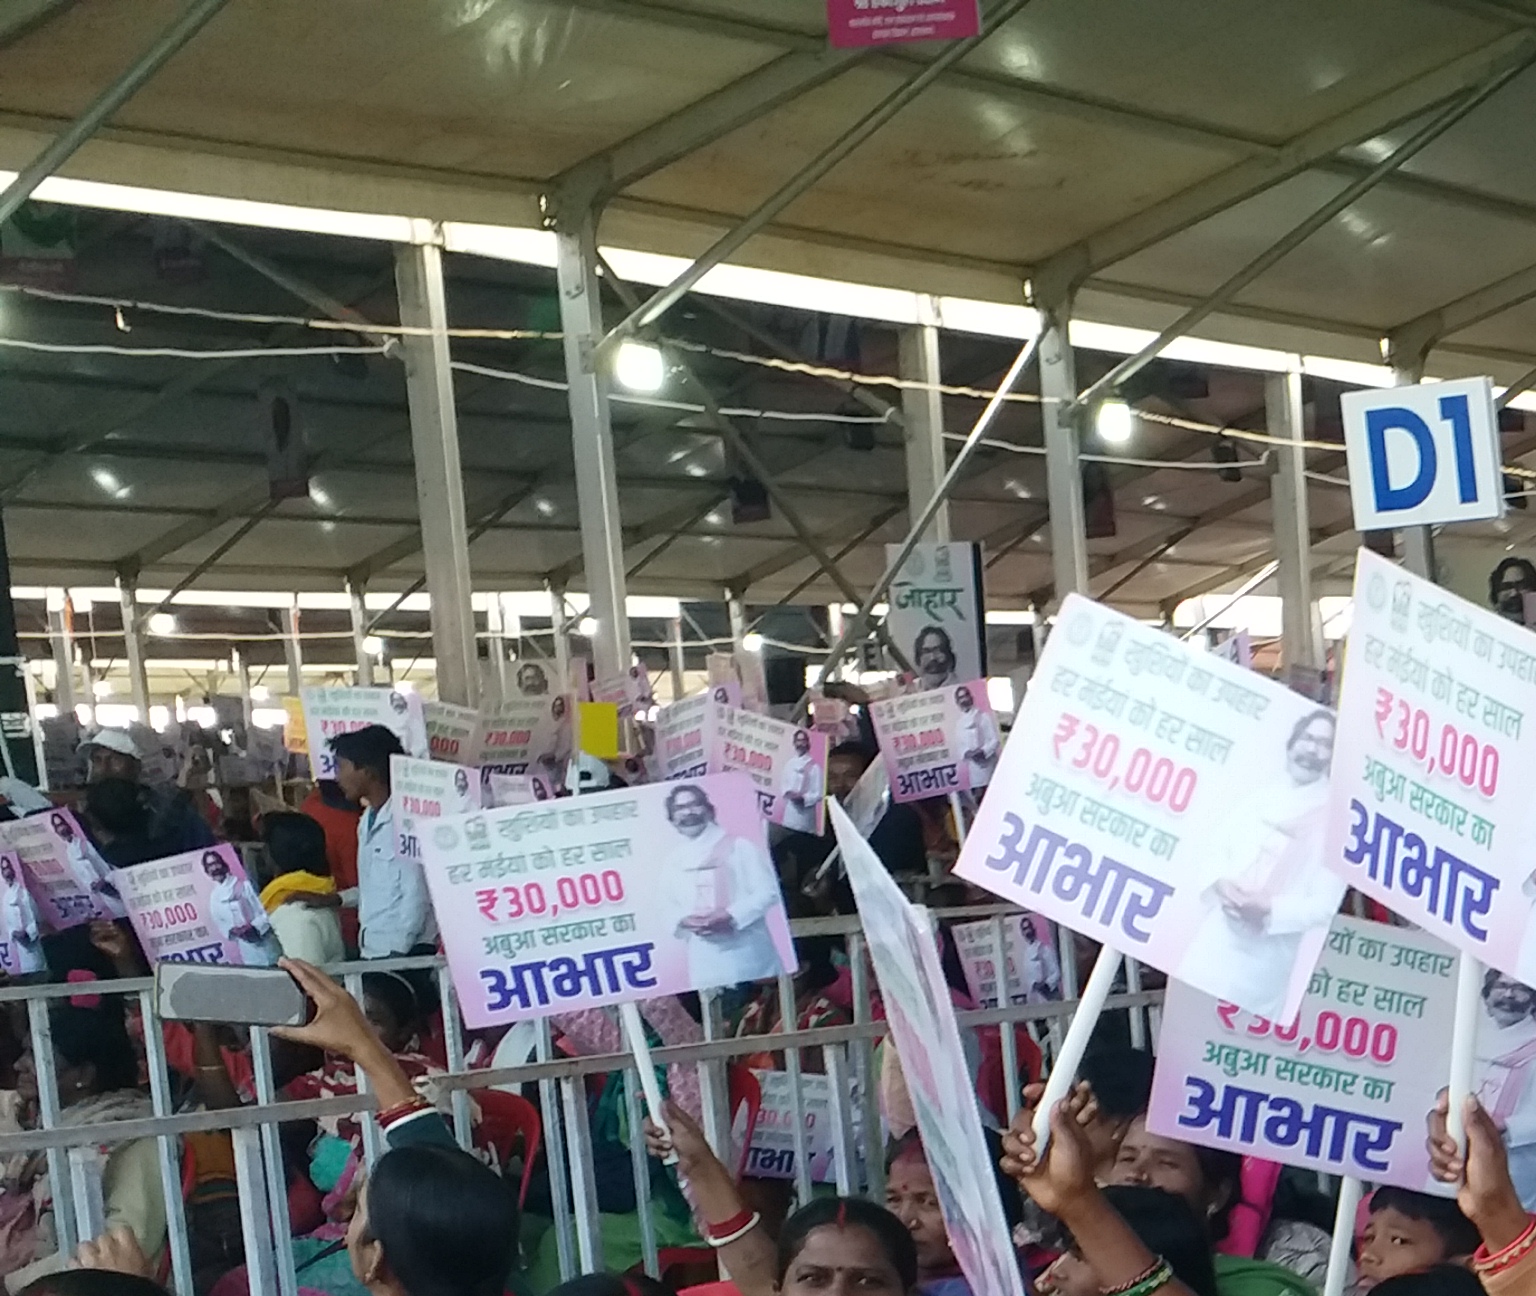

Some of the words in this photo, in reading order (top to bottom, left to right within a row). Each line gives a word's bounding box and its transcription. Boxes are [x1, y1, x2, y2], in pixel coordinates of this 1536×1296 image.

[1364, 394, 1478, 514] D1
[1373, 687, 1498, 796] ₹30,000
[897, 763, 963, 796] आभार
[475, 869, 624, 921] ₹30,000
[1343, 798, 1498, 943] आभार
[479, 942, 657, 1011] आभार
[1359, 935, 1387, 961] का
[1391, 943, 1456, 976] उपहार
[1337, 977, 1370, 1005] हर
[1374, 985, 1428, 1017] साल
[1202, 1041, 1270, 1077] अबुआ
[1274, 1056, 1359, 1095] सरकार
[1363, 1076, 1395, 1103] का
[1179, 1076, 1402, 1171] आभार
